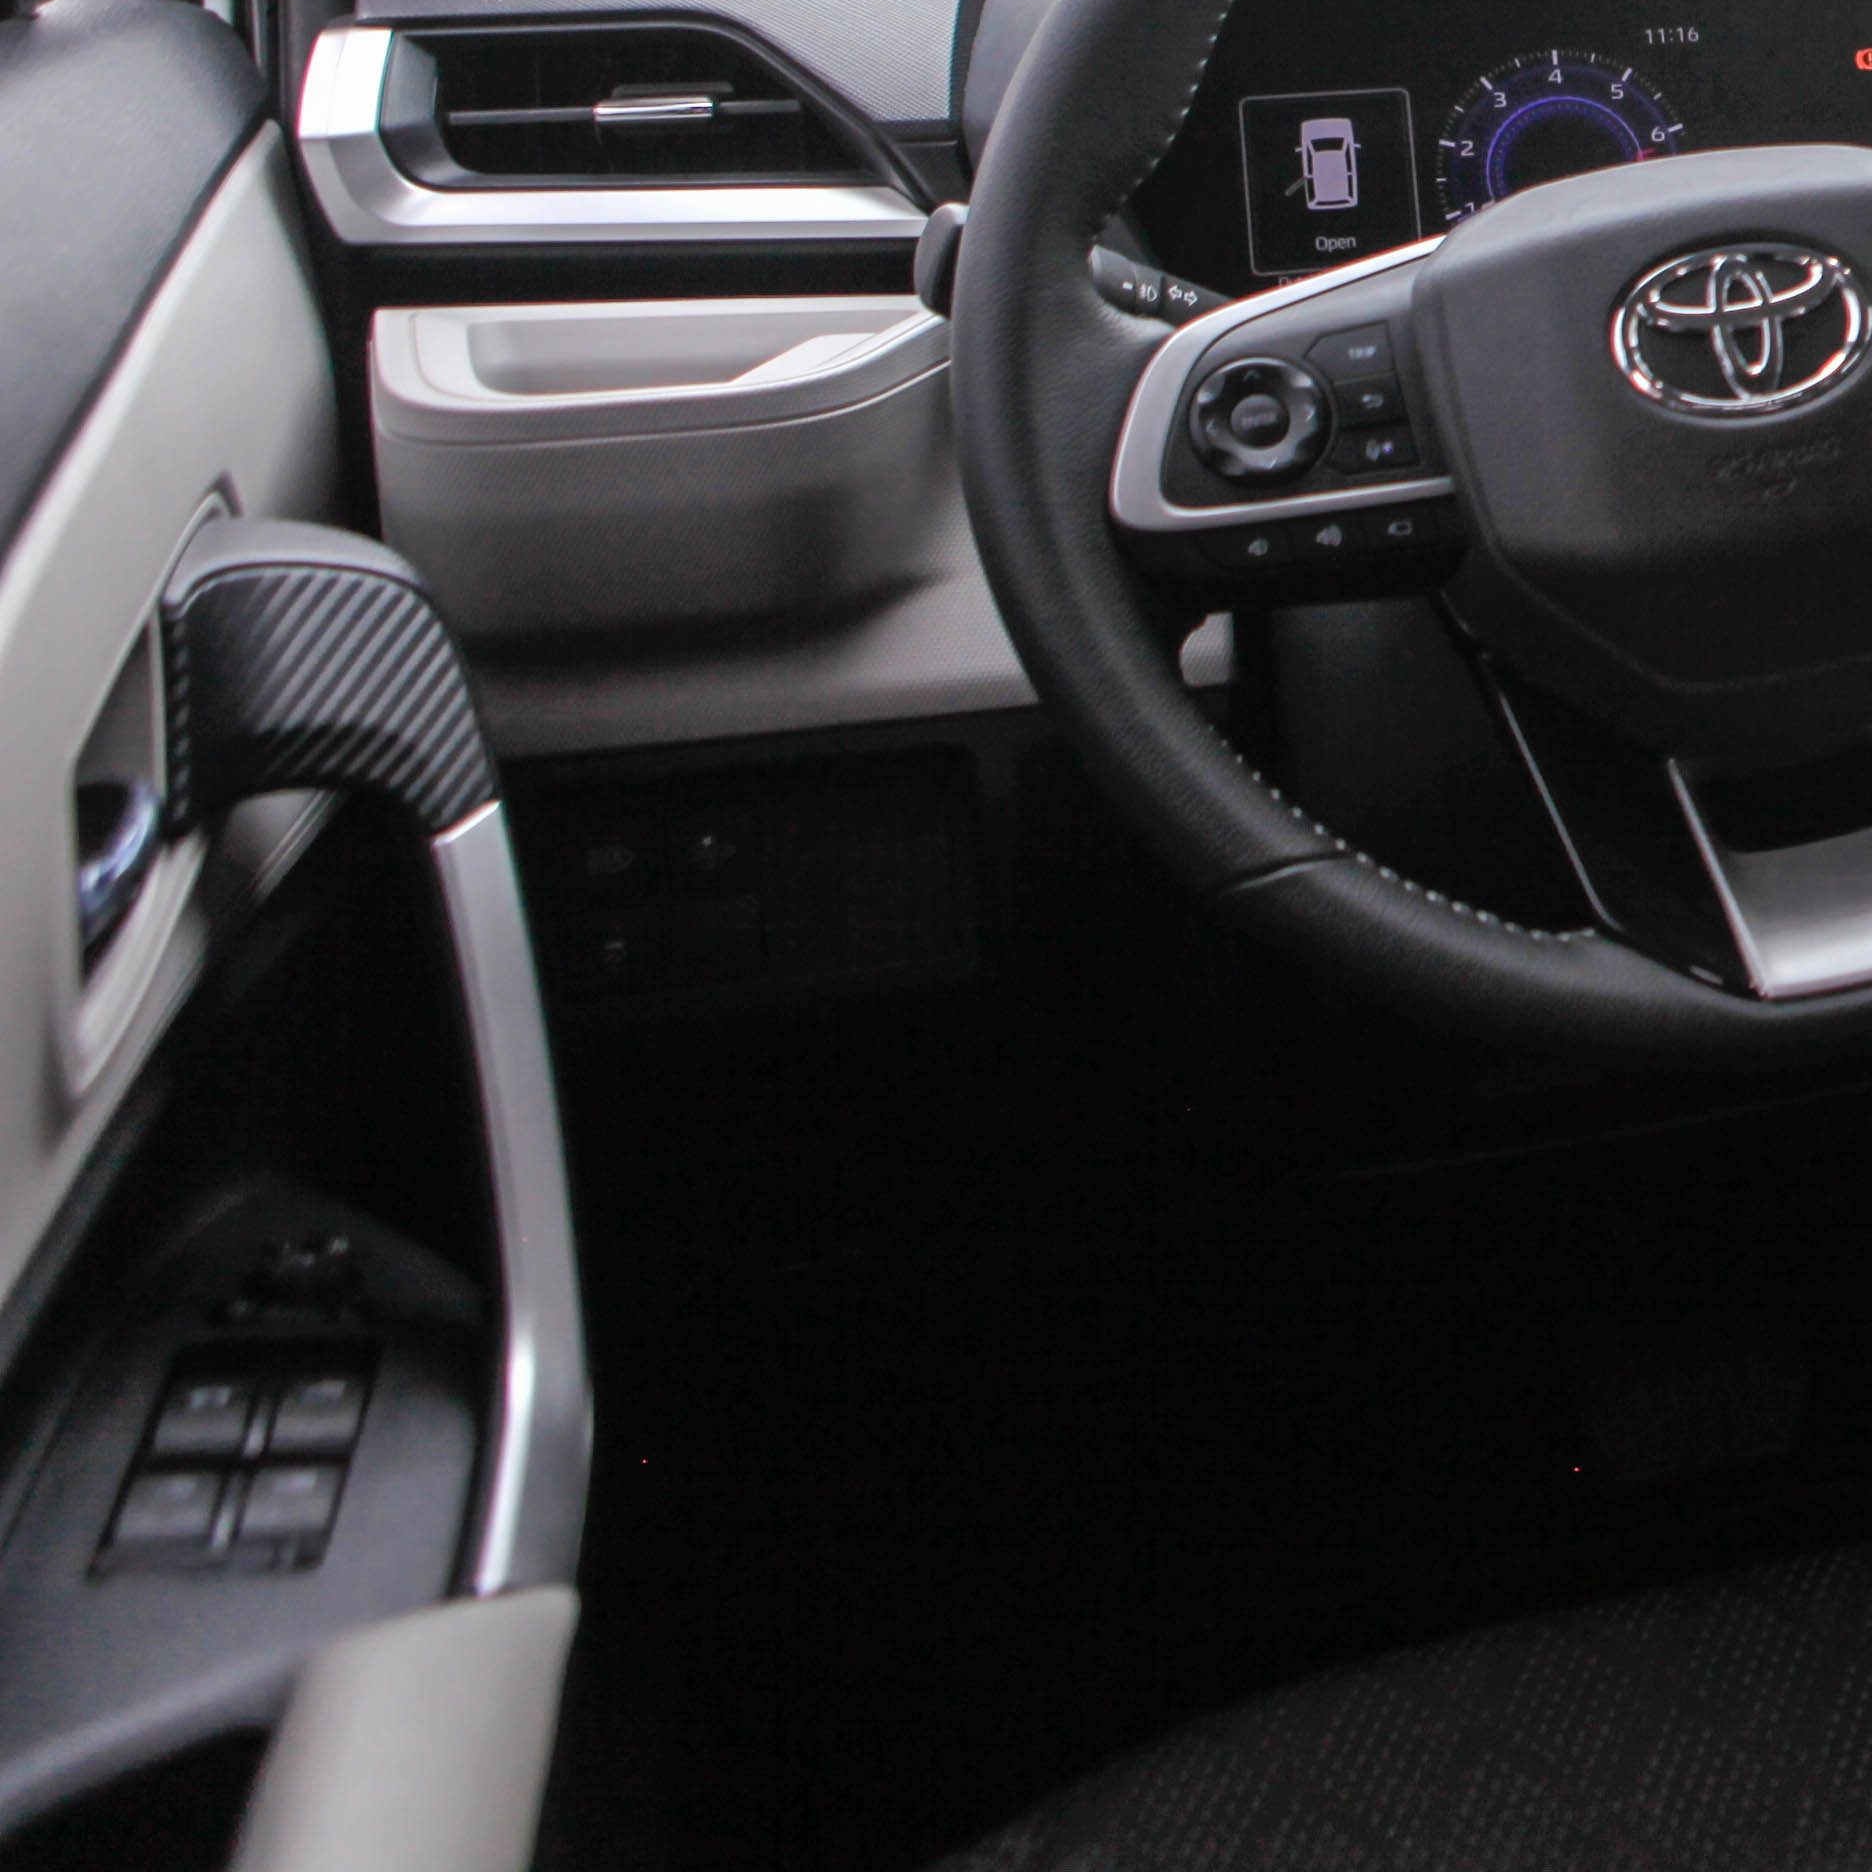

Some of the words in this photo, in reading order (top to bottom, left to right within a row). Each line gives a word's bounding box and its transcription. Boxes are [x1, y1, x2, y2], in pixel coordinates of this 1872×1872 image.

[1645, 27, 1700, 45] 11:16
[1548, 68, 1563, 84] 4
[1493, 91, 1507, 108] 3
[1610, 84, 1624, 100] 5
[1651, 127, 1665, 142] 6
[1460, 140, 1475, 156] 2
[1315, 235, 1357, 253] Open
